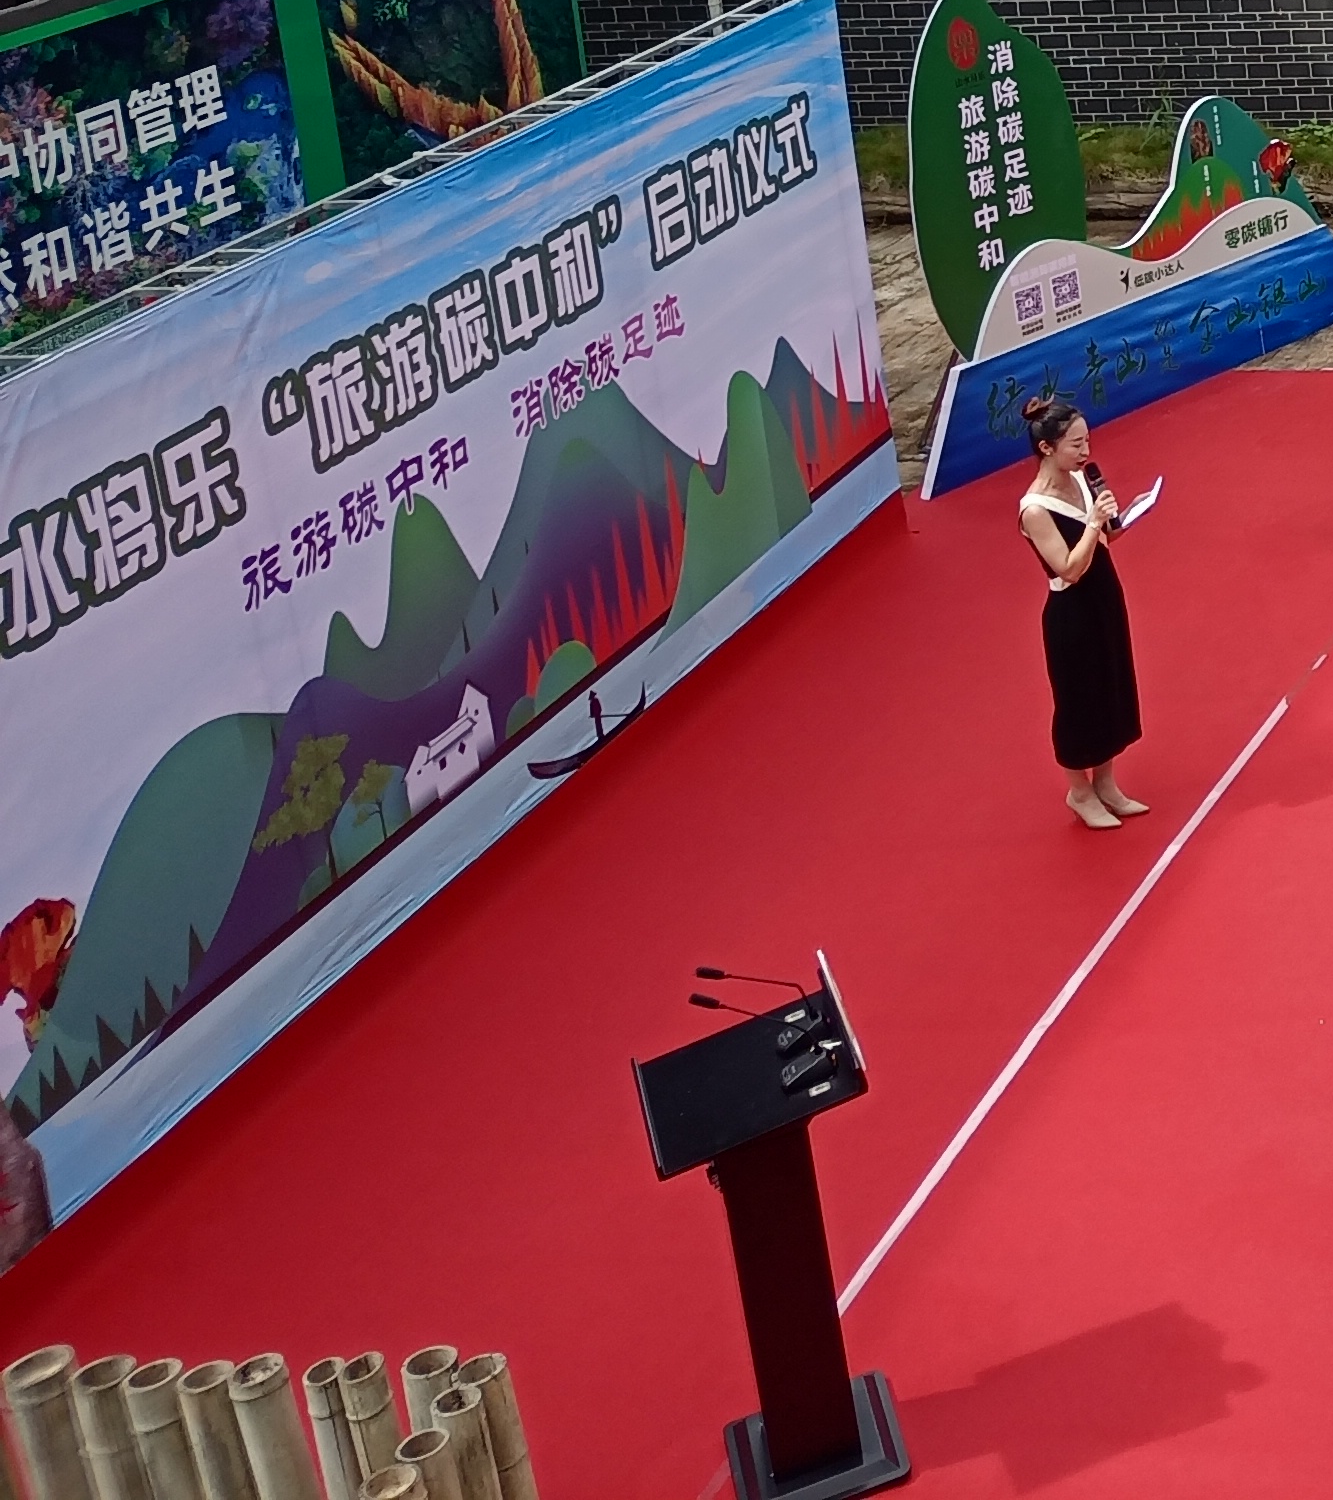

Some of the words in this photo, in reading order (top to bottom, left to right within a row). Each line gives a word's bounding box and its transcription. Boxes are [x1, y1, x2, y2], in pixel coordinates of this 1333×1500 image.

[958, 94, 1005, 272] 旅游碳中和
[987, 40, 1034, 217] 消除碳足迹
[1133, 259, 1185, 288] 低碳小达人
[241, 435, 469, 612] 旅游碳中和
[509, 293, 686, 437] 消除碳足迹
